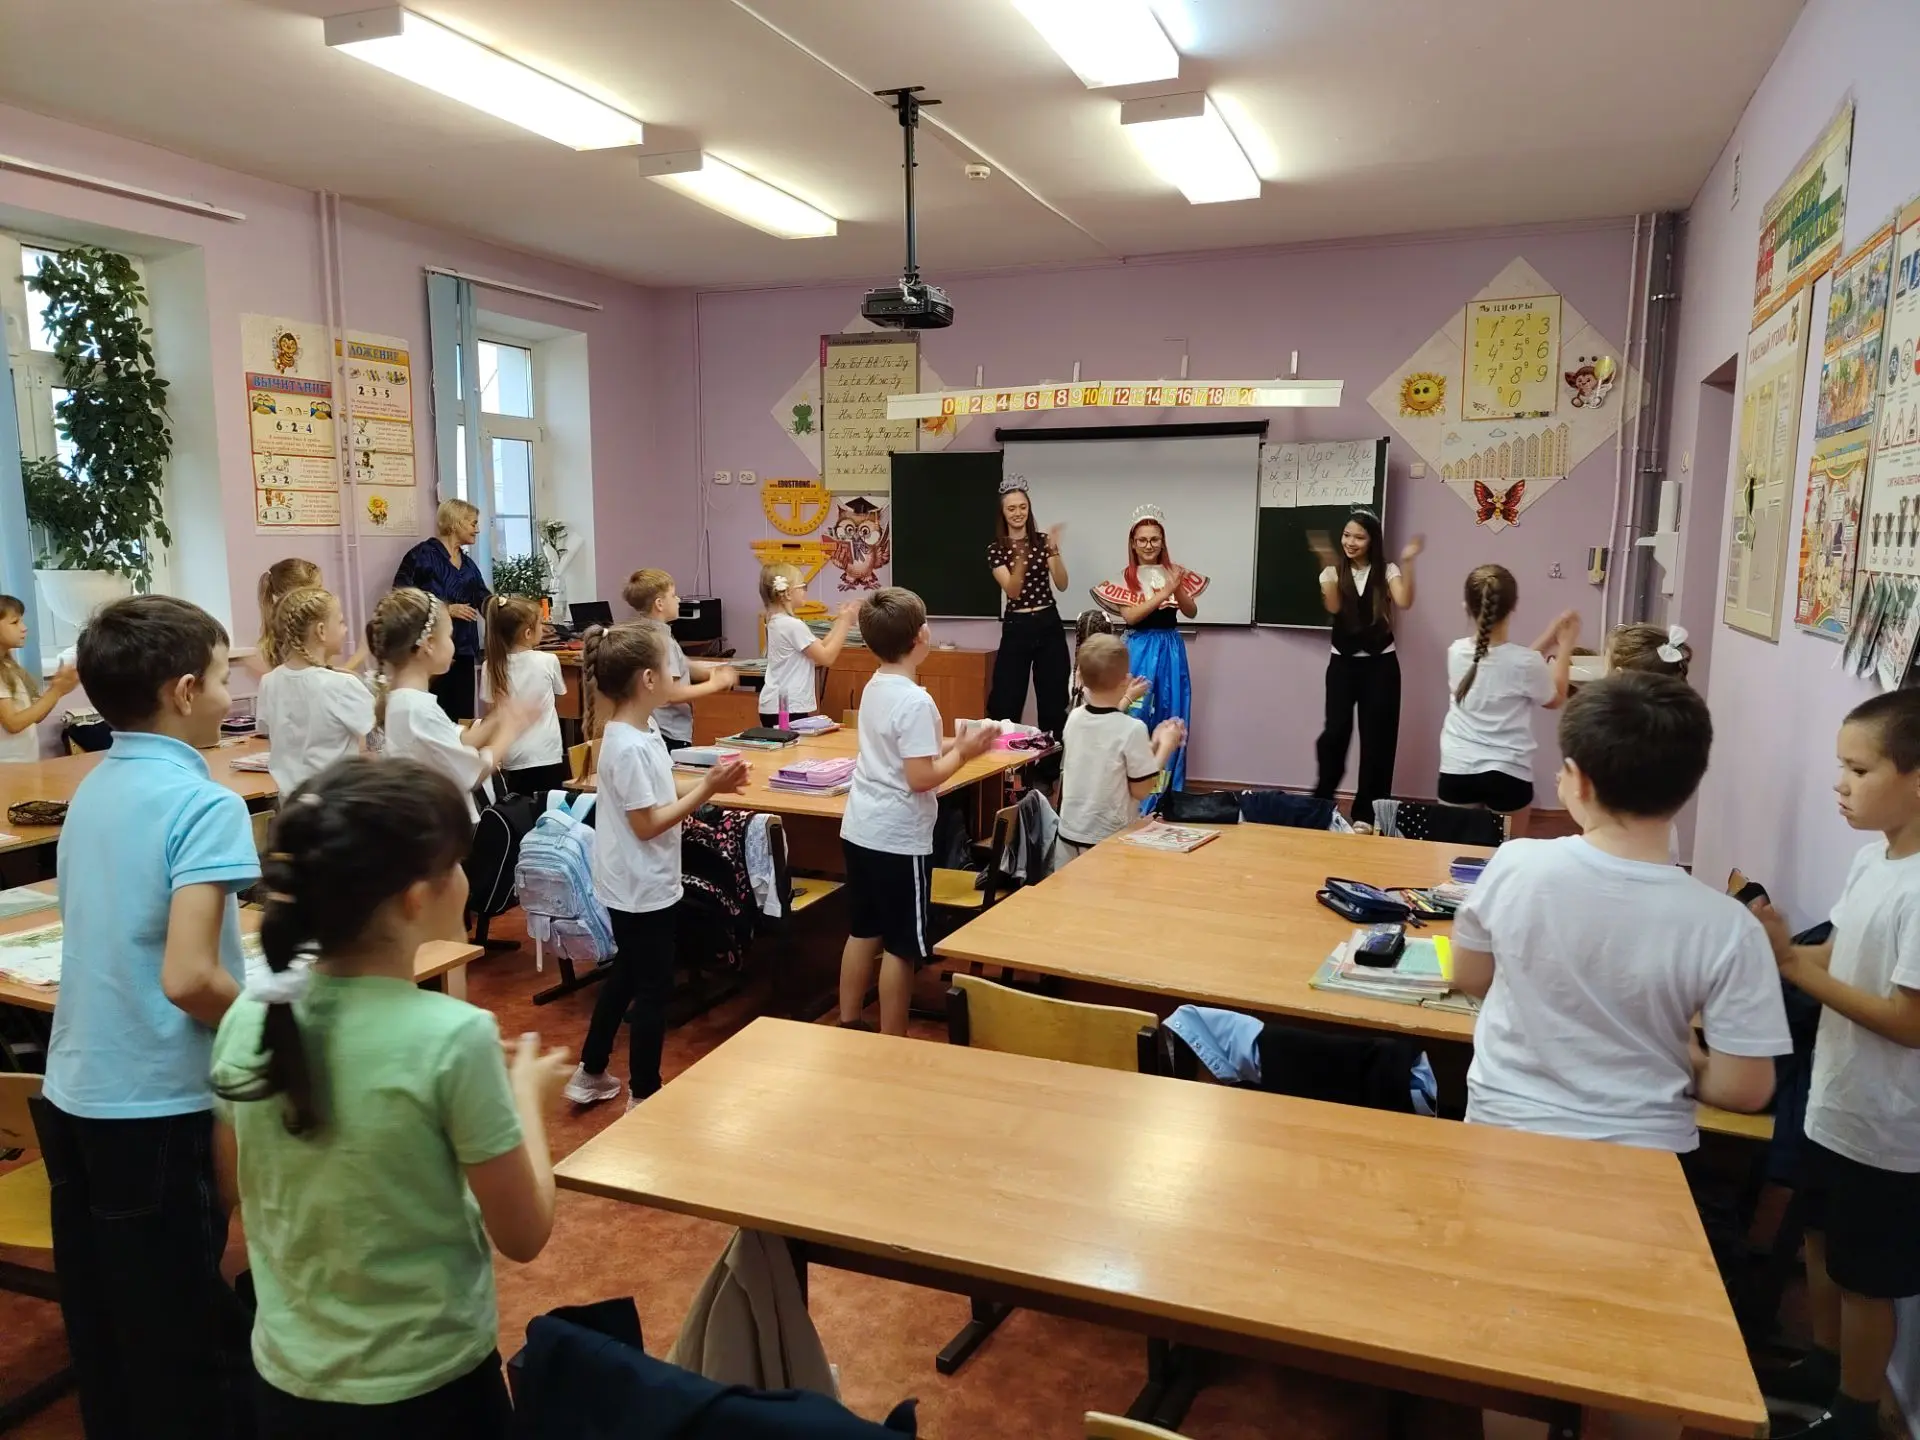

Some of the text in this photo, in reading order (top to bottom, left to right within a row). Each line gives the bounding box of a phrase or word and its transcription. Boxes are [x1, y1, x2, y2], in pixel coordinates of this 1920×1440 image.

[1494, 303, 1533, 312] ЦИФРЫ
[1490, 320, 1500, 338] 1
[1513, 319, 1525, 337] 2
[1538, 317, 1550, 334] 3
[347, 345, 399, 361] ЛОЖЕНИЕ
[1488, 344, 1499, 361] 4
[1512, 342, 1524, 360] 5
[1537, 340, 1549, 358] 6
[1488, 367, 1498, 386] 7
[1510, 366, 1522, 384] 8
[1536, 364, 1548, 382] 9
[253, 376, 328, 394] ВЫЧИТАНИЕ
[358, 386, 390, 398] 2 3 5
[944, 398, 954, 414] 0
[970, 396, 982, 412] 2
[983, 396, 994, 411] 3
[997, 394, 1010, 410] 4
[1012, 394, 1024, 409] 5
[1026, 392, 1038, 407] 6
[1041, 391, 1052, 407] 7
[1056, 390, 1068, 405] 8
[1072, 388, 1082, 404] 9
[1085, 388, 1098, 404] 10
[1116, 388, 1130, 404] 12
[1147, 388, 1161, 404] 14
[1177, 388, 1191, 404] 16
[1194, 388, 1206, 404] 17
[1209, 388, 1222, 404] 18
[1240, 388, 1256, 404] 20
[1508, 390, 1522, 408] 0
[276, 421, 282, 430] 6
[292, 422, 298, 432] 2
[306, 424, 312, 433] 4
[272, 476, 278, 484] 3
[284, 476, 290, 484] 2
[262, 511, 292, 520] 4 1 3
